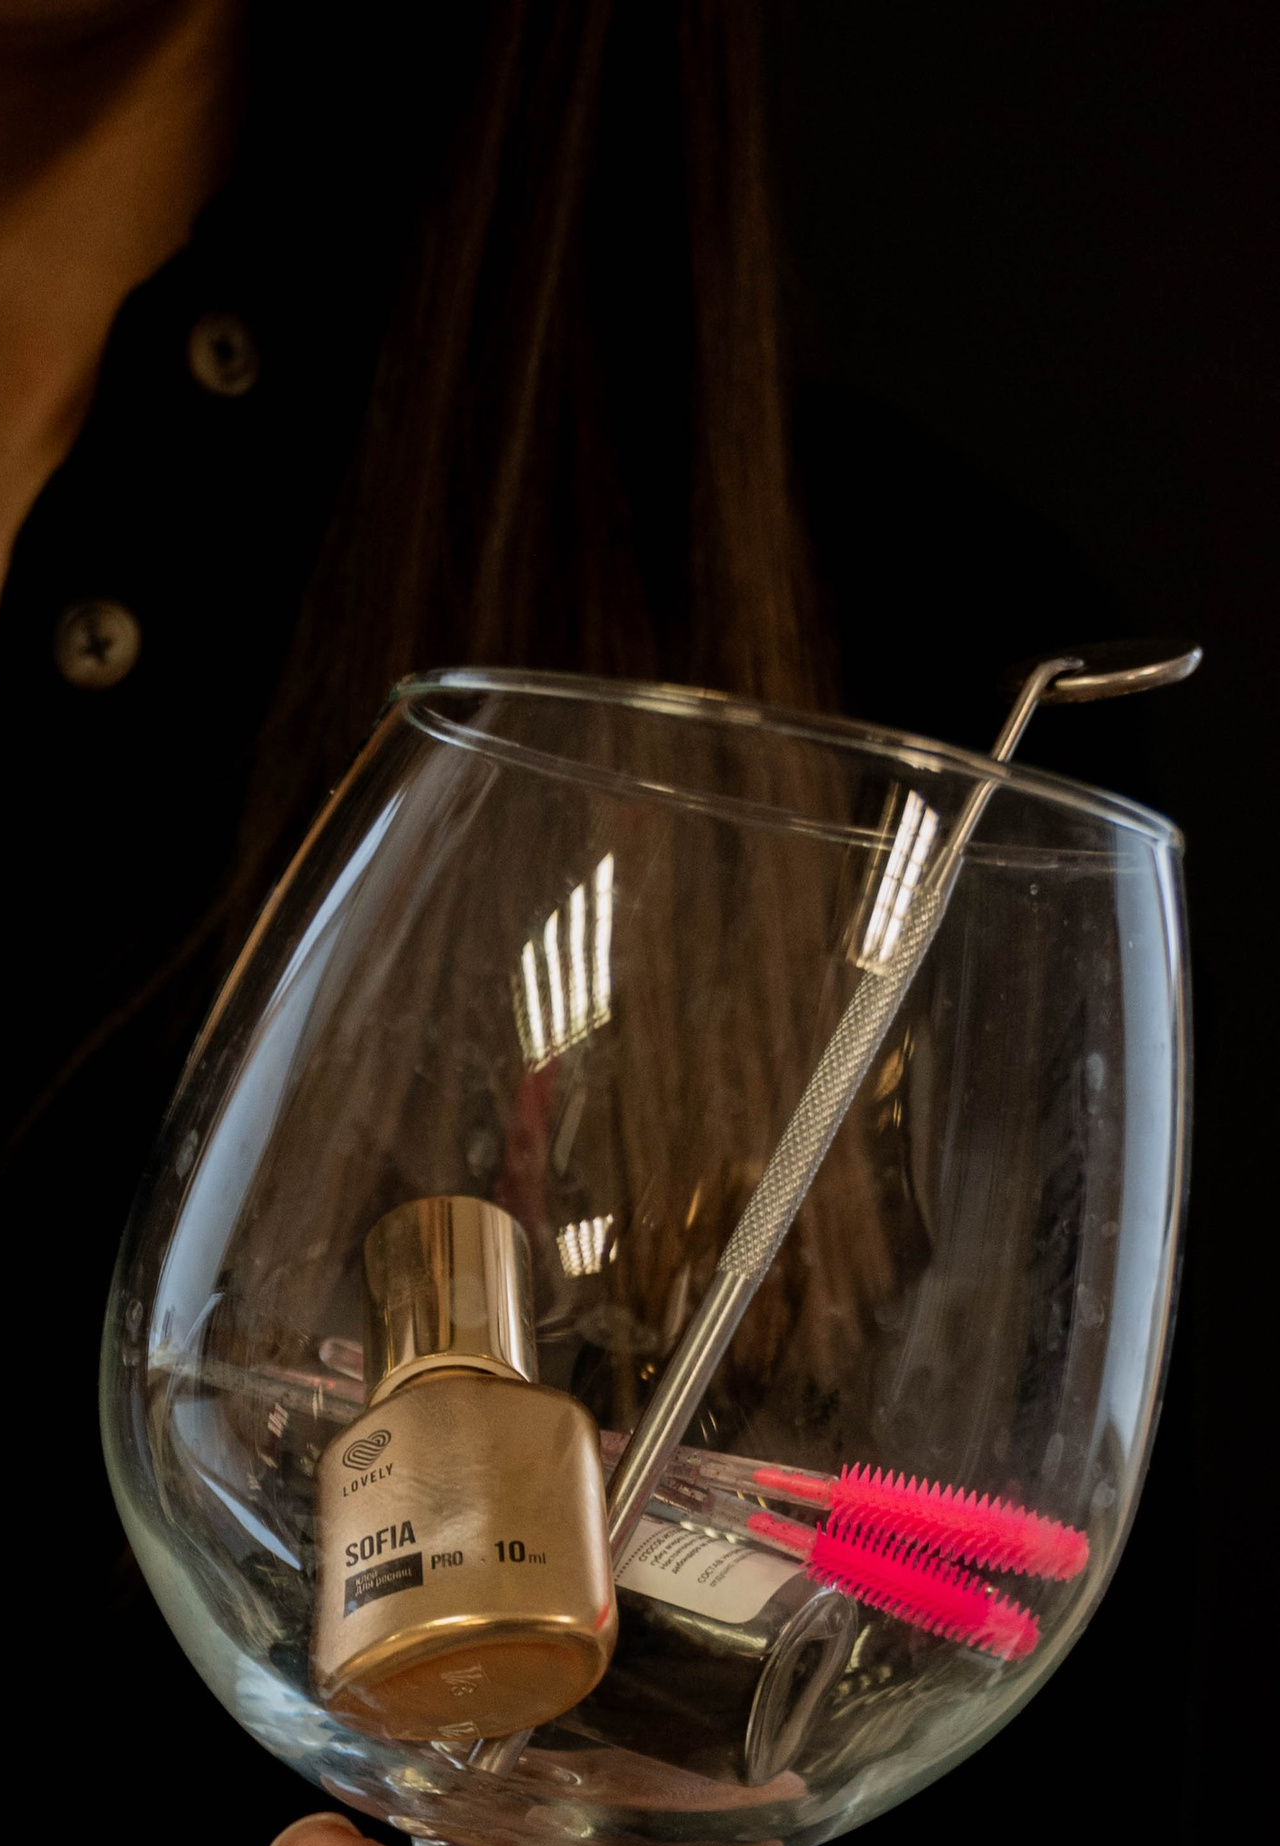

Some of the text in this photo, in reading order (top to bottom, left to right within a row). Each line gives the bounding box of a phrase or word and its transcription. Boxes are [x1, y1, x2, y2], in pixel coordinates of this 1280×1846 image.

[342, 1462, 394, 1498] LOVELY
[344, 1519, 417, 1568] SOFIA
[430, 1550, 464, 1570] PRO
